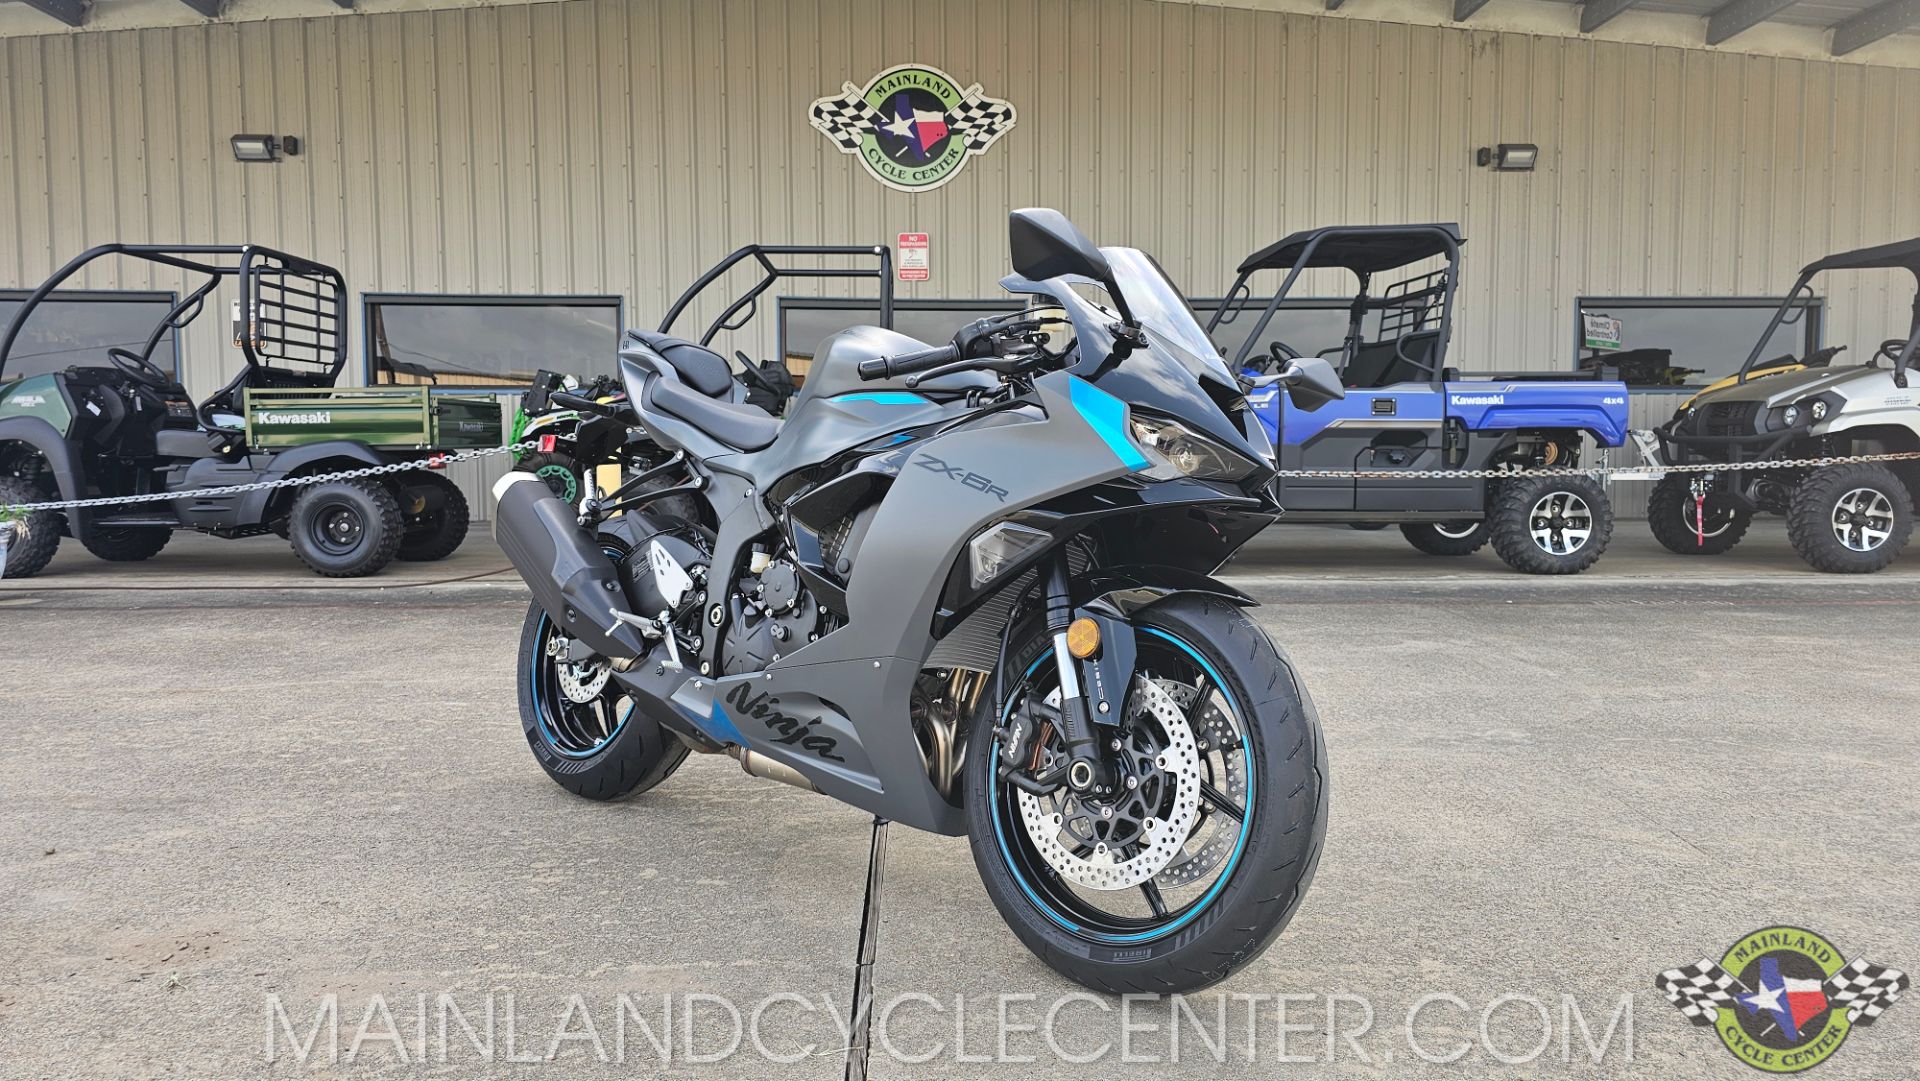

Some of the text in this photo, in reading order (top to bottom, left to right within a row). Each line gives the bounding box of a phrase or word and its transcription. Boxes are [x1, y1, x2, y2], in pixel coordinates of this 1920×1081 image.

[875, 74, 951, 98] MAINLAND
[868, 148, 959, 181] CYCLE CENTER
[1451, 395, 1504, 405] Kawasaki
[1603, 396, 1624, 404] 4x4
[258, 412, 331, 424] Kawasaki
[913, 453, 1009, 502] ZX-6R
[726, 681, 845, 763] Ninja
[1113, 948, 1152, 962] PIRELLI
